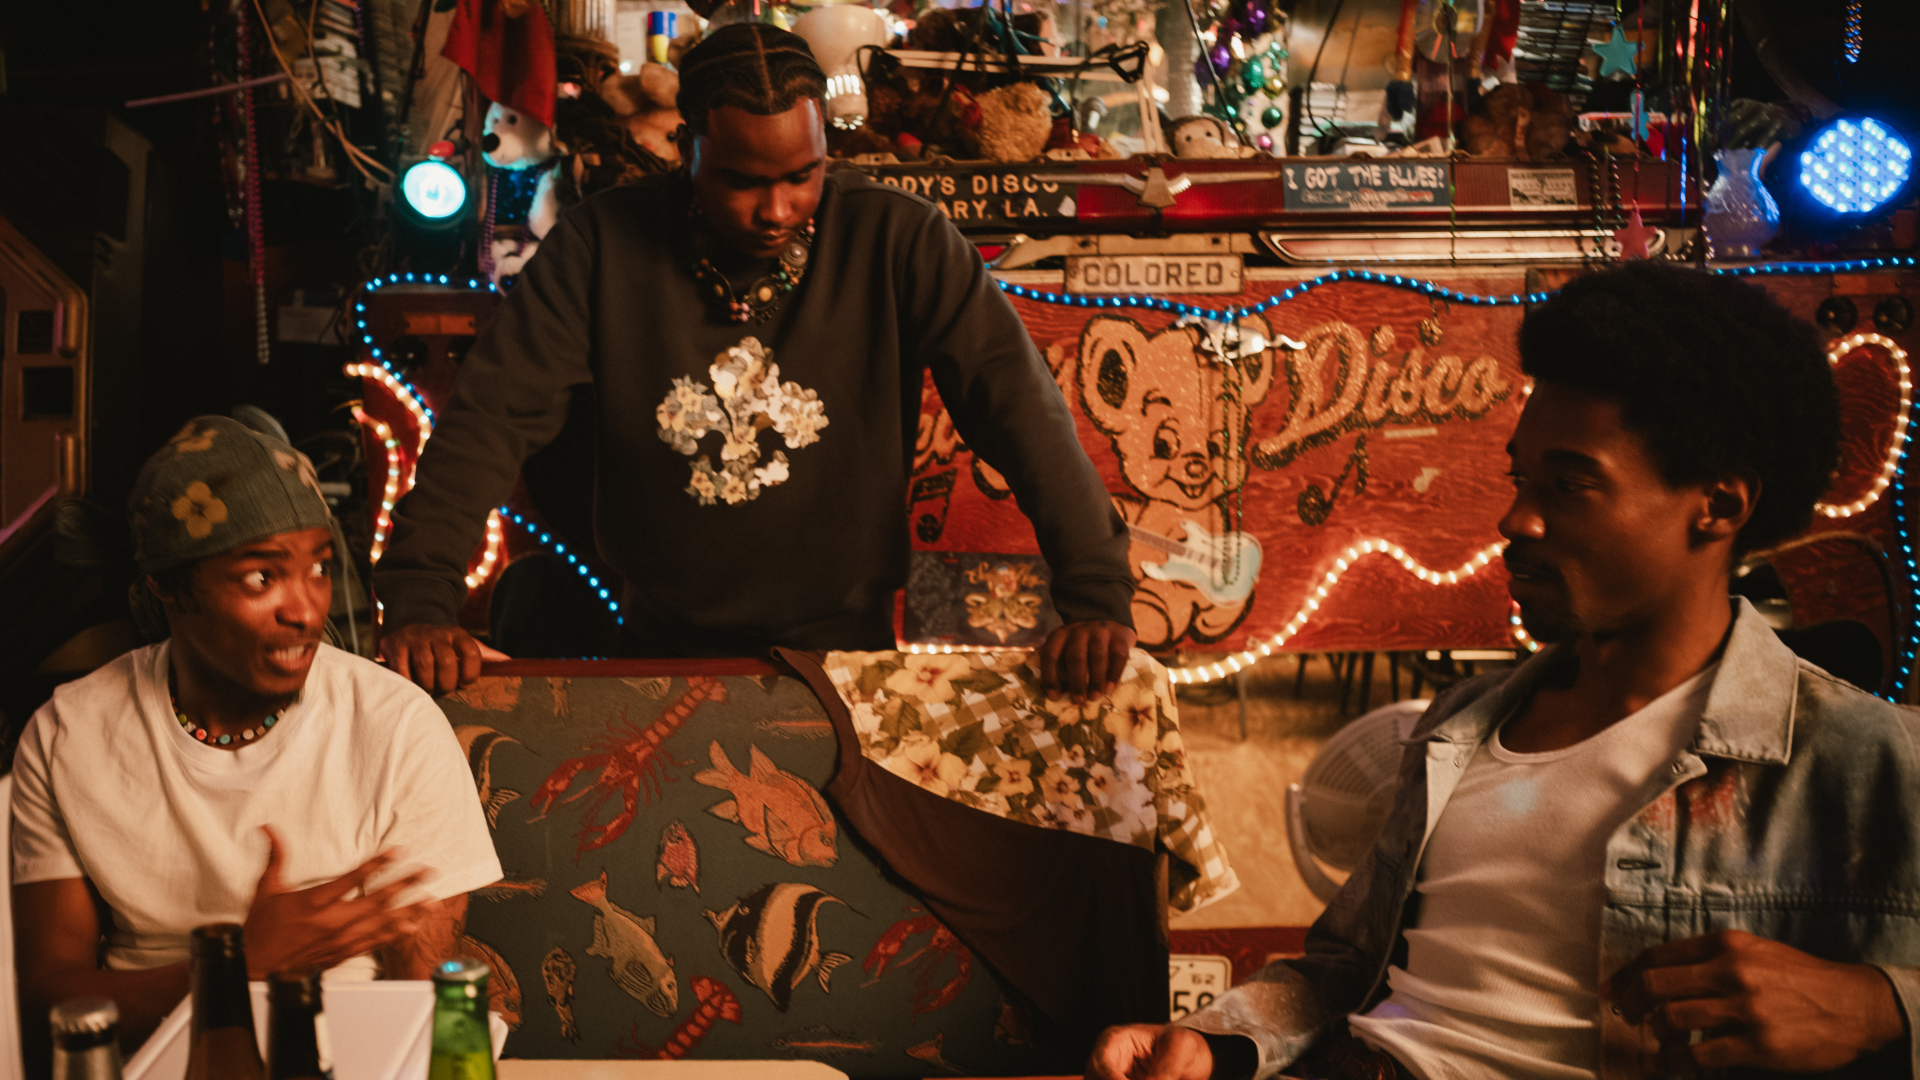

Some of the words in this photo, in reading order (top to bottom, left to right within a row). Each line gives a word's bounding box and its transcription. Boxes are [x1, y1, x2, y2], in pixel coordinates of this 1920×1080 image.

[868, 173, 956, 196] DDY'S
[1284, 167, 1299, 190] I
[1304, 165, 1341, 189] GOT
[1347, 164, 1383, 188] THE
[1388, 164, 1445, 189] BLUES!
[1083, 262, 1224, 287] COLORED
[1252, 321, 1511, 470] Disco
